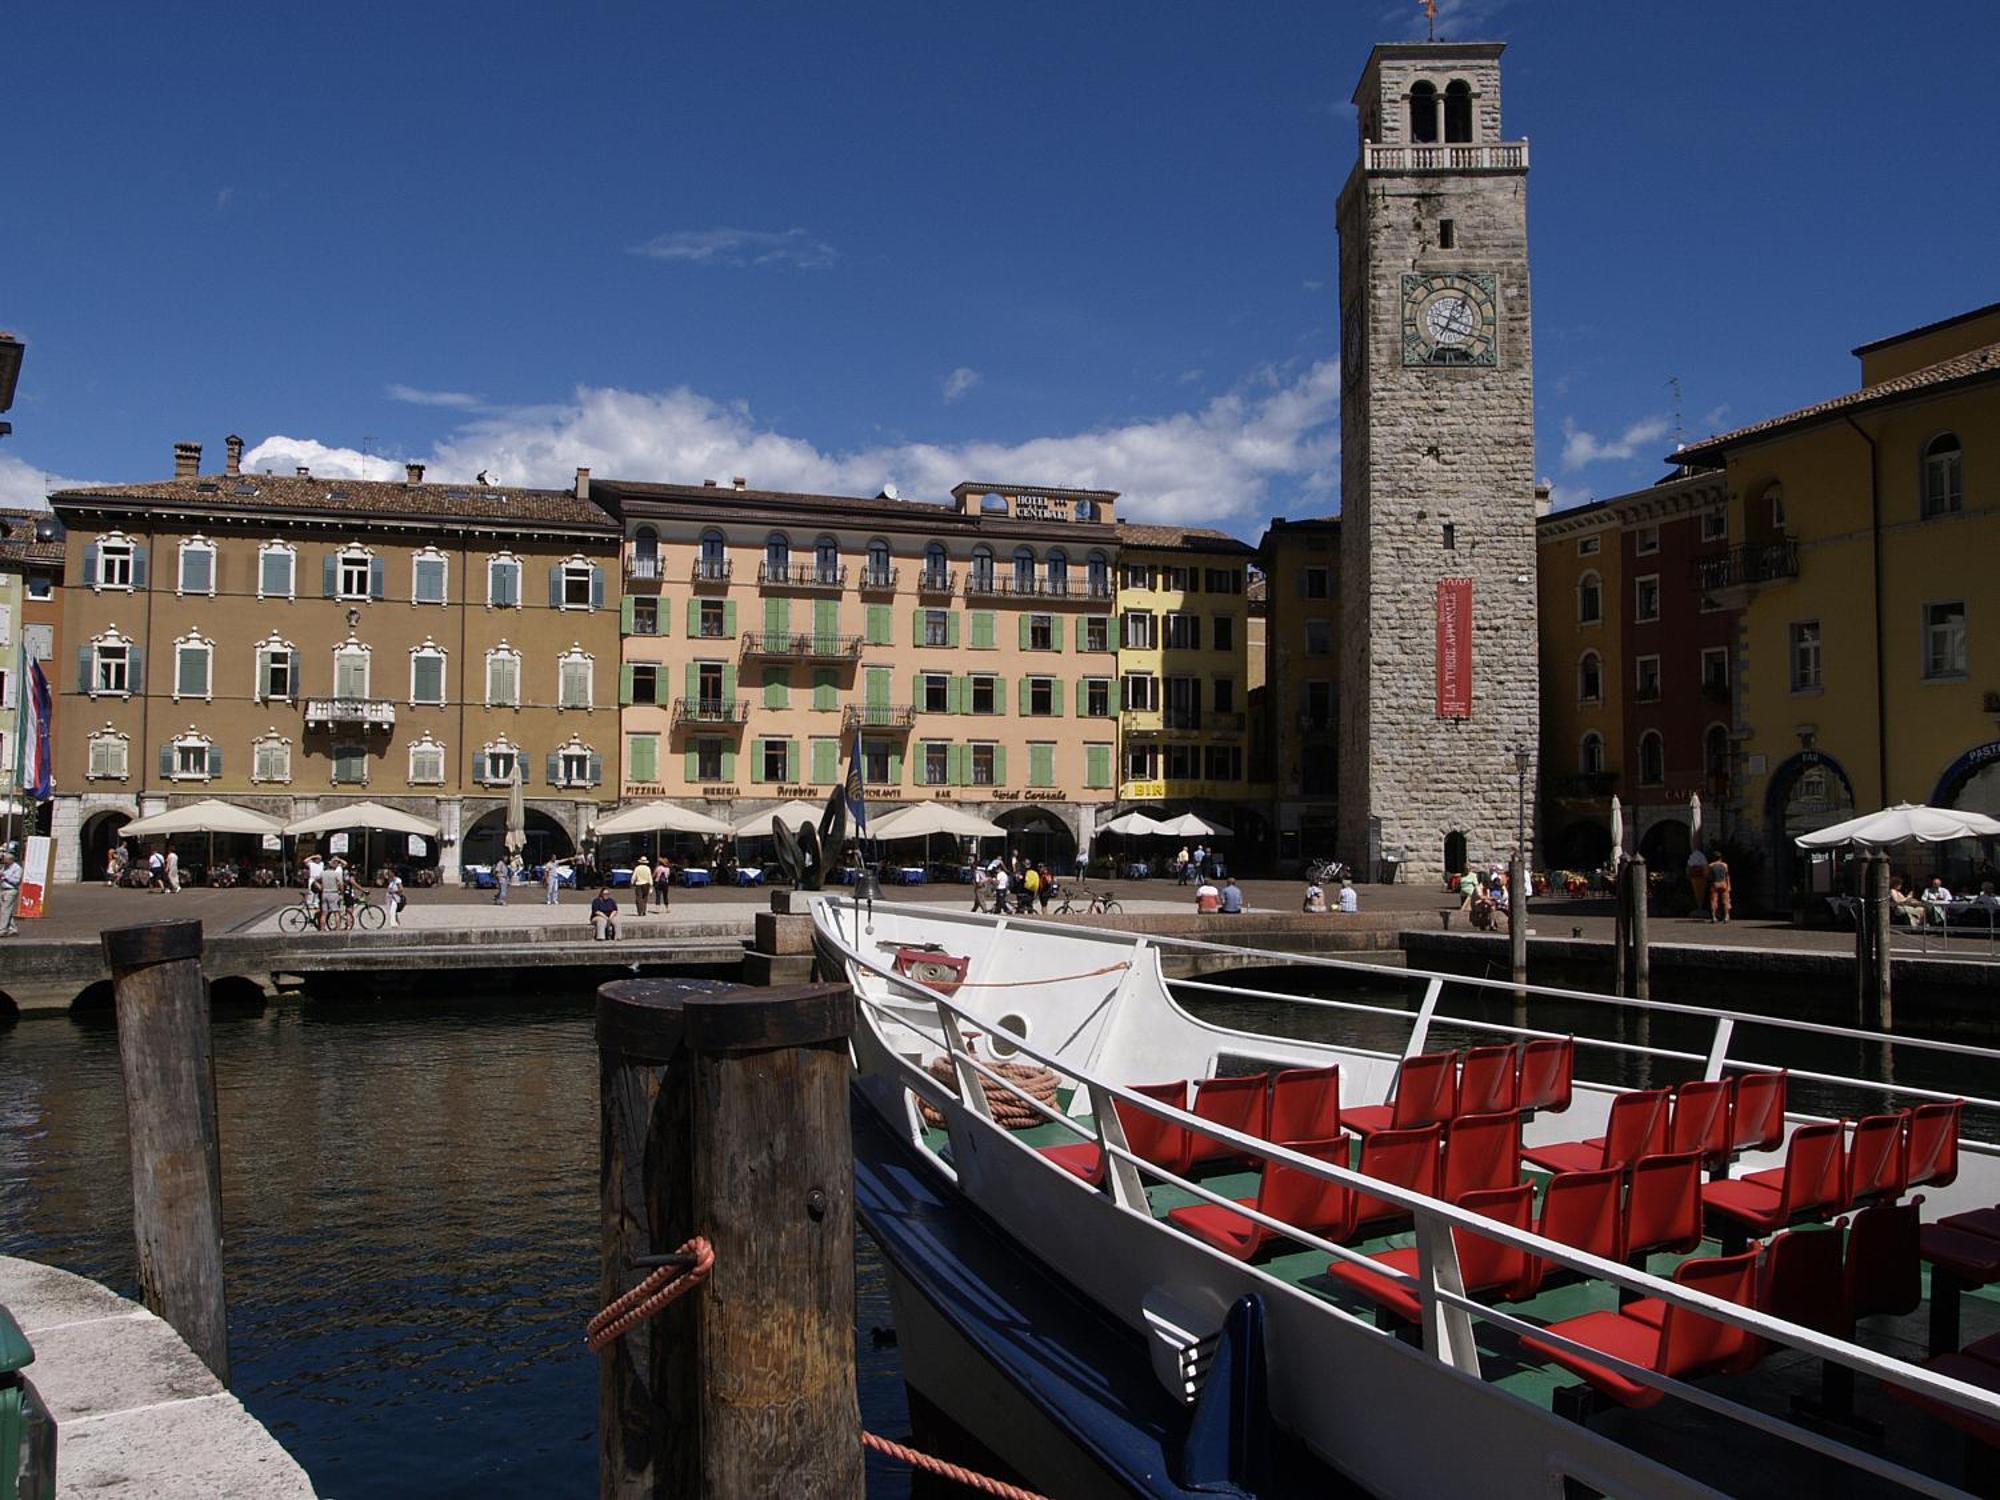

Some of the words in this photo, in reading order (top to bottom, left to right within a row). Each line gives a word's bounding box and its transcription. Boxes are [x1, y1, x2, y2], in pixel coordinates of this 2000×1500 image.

[1017, 495, 1048, 505] HOTEL
[1017, 507, 1068, 519] CENTRALE
[1445, 648, 1456, 681] TORRE
[1445, 684, 1456, 698] LA
[626, 786, 666, 795] PIZZERIA
[702, 787, 741, 796] BIRRERIA
[864, 789, 901, 799] TORANTE
[935, 790, 951, 799] BAR
[992, 790, 1020, 801] Hotel
[1024, 790, 1067, 801] Centrale
